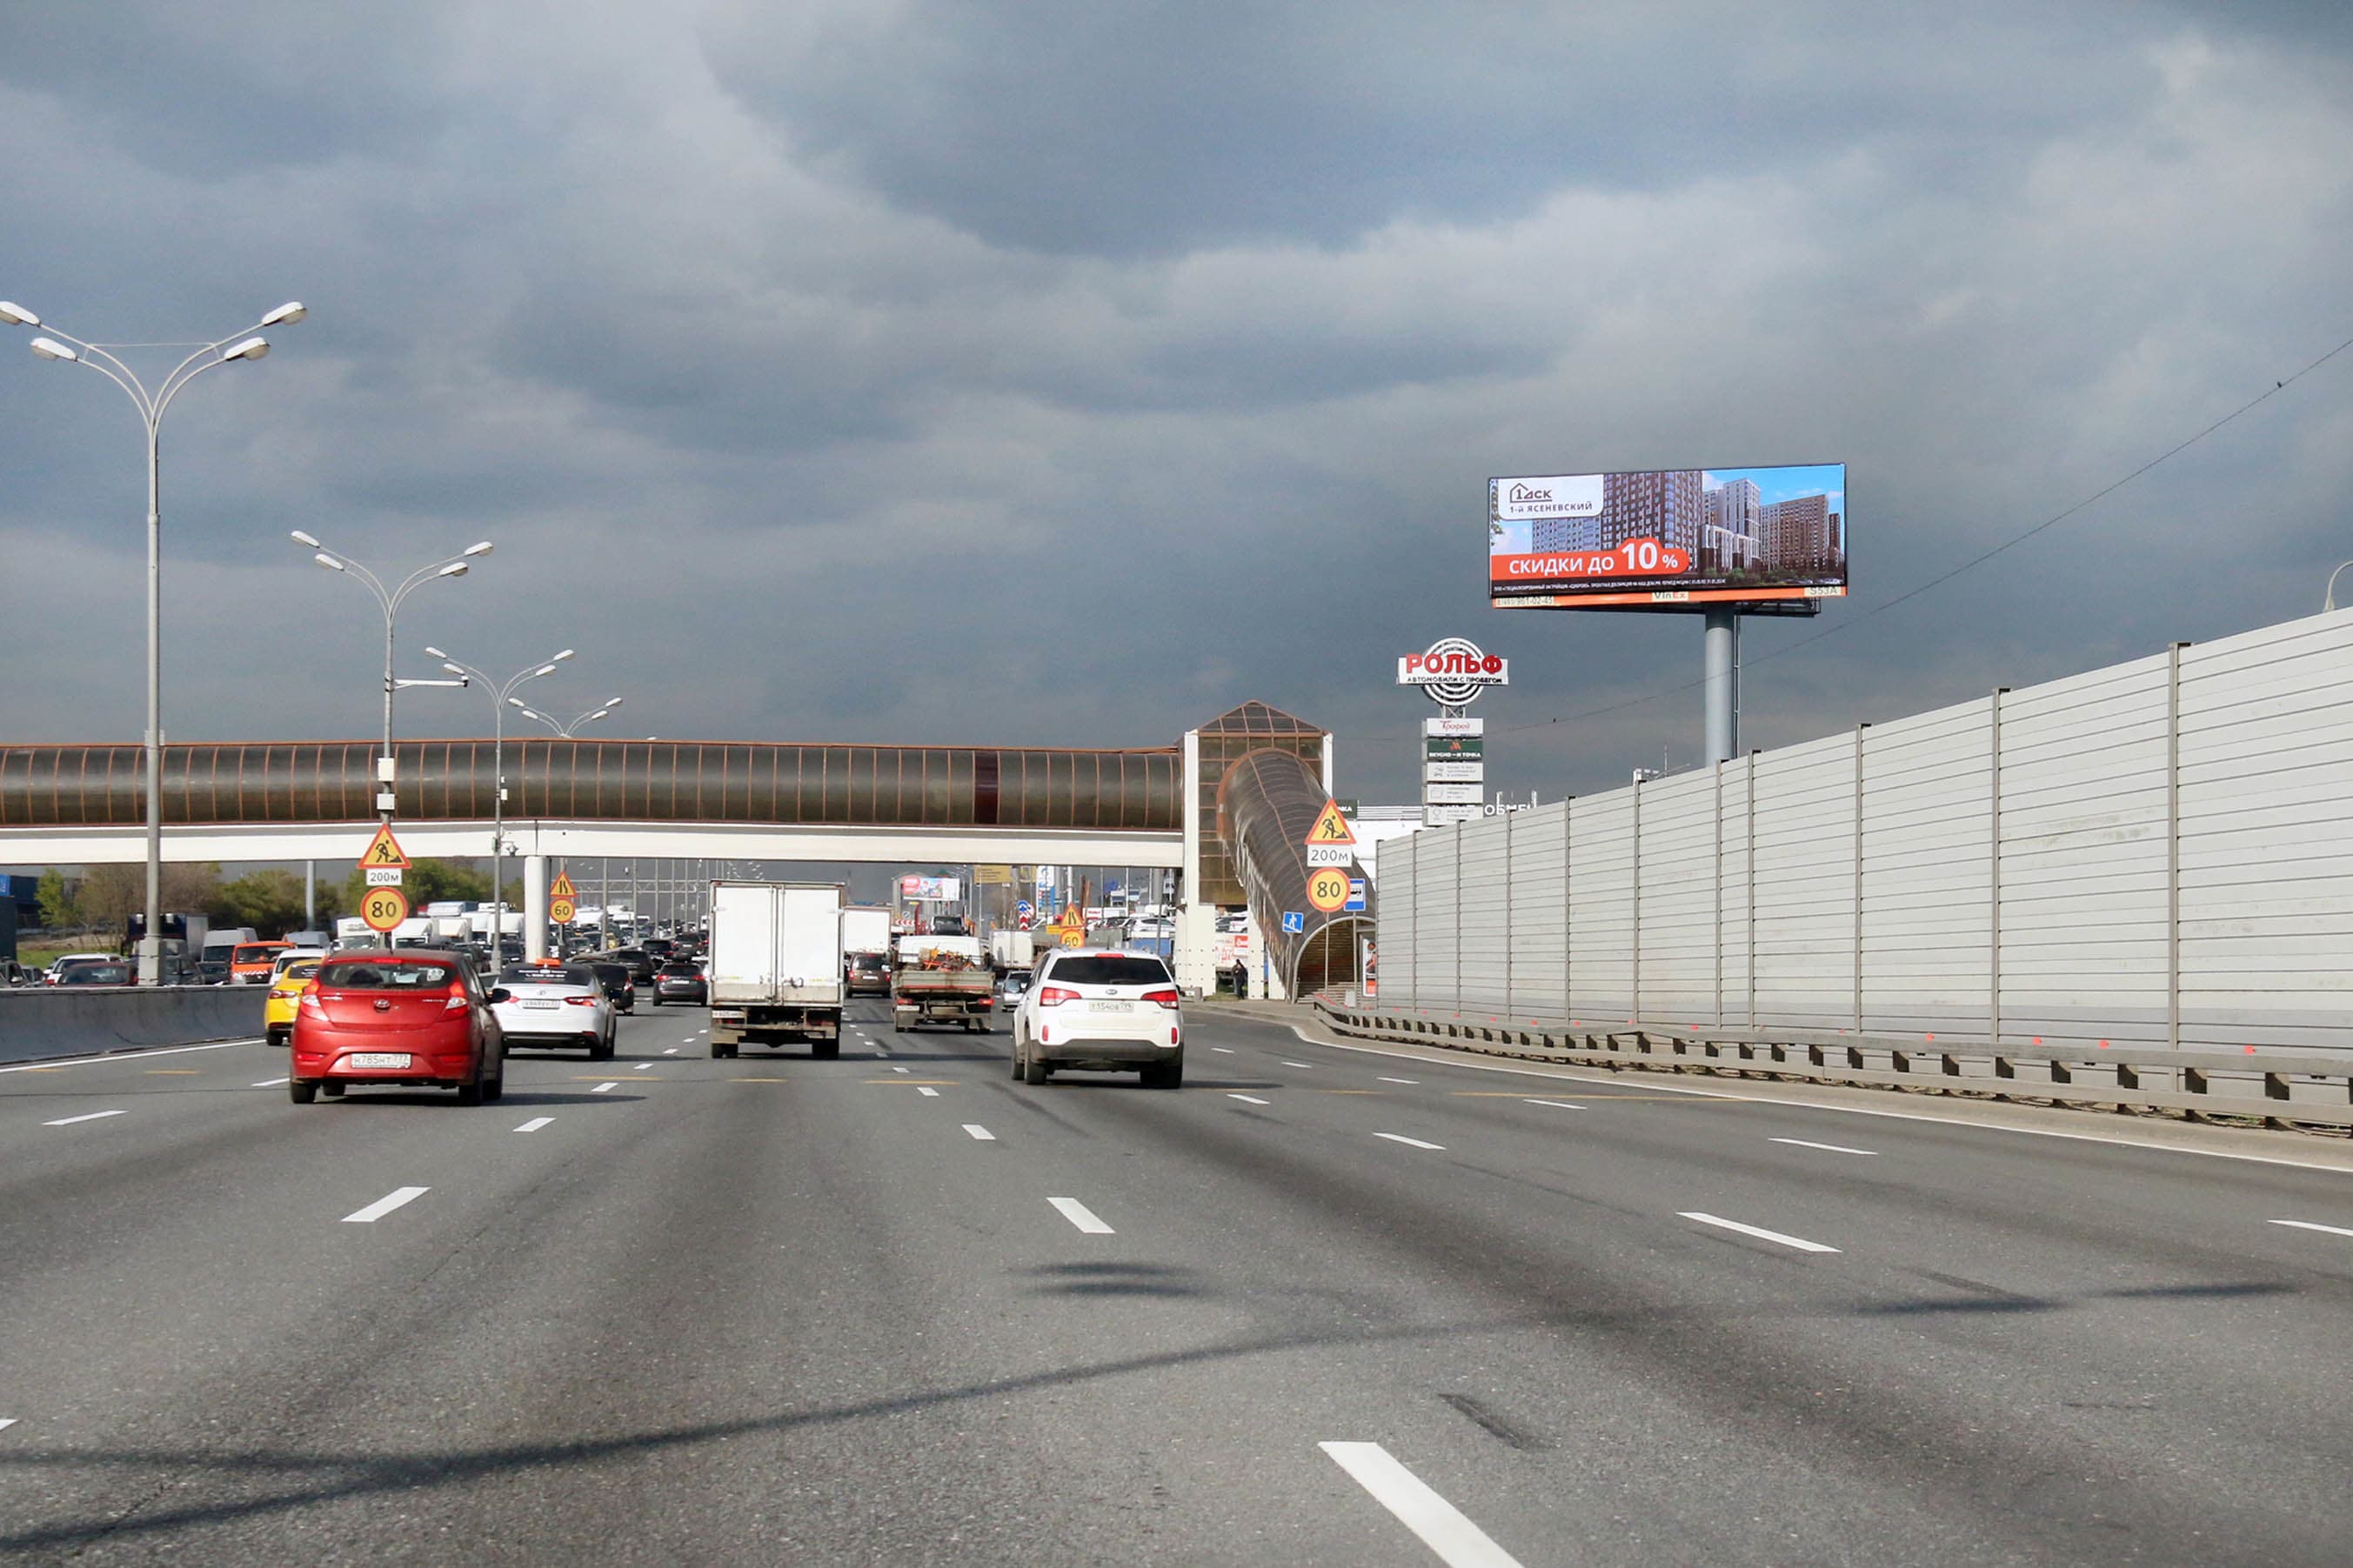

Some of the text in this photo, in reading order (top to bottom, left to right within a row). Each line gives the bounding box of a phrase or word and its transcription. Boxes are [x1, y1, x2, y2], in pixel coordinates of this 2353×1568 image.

[1527, 501, 1593, 513] ЯСЕНЕВСКИЙ
[1509, 542, 1678, 576] СКИДКИ ДО 10 %
[1406, 653, 1502, 674] РОЛЬФ
[1317, 881, 1340, 897] 80
[371, 901, 397, 918] 80
[554, 905, 570, 916] 60
[1064, 937, 1080, 947] 60
